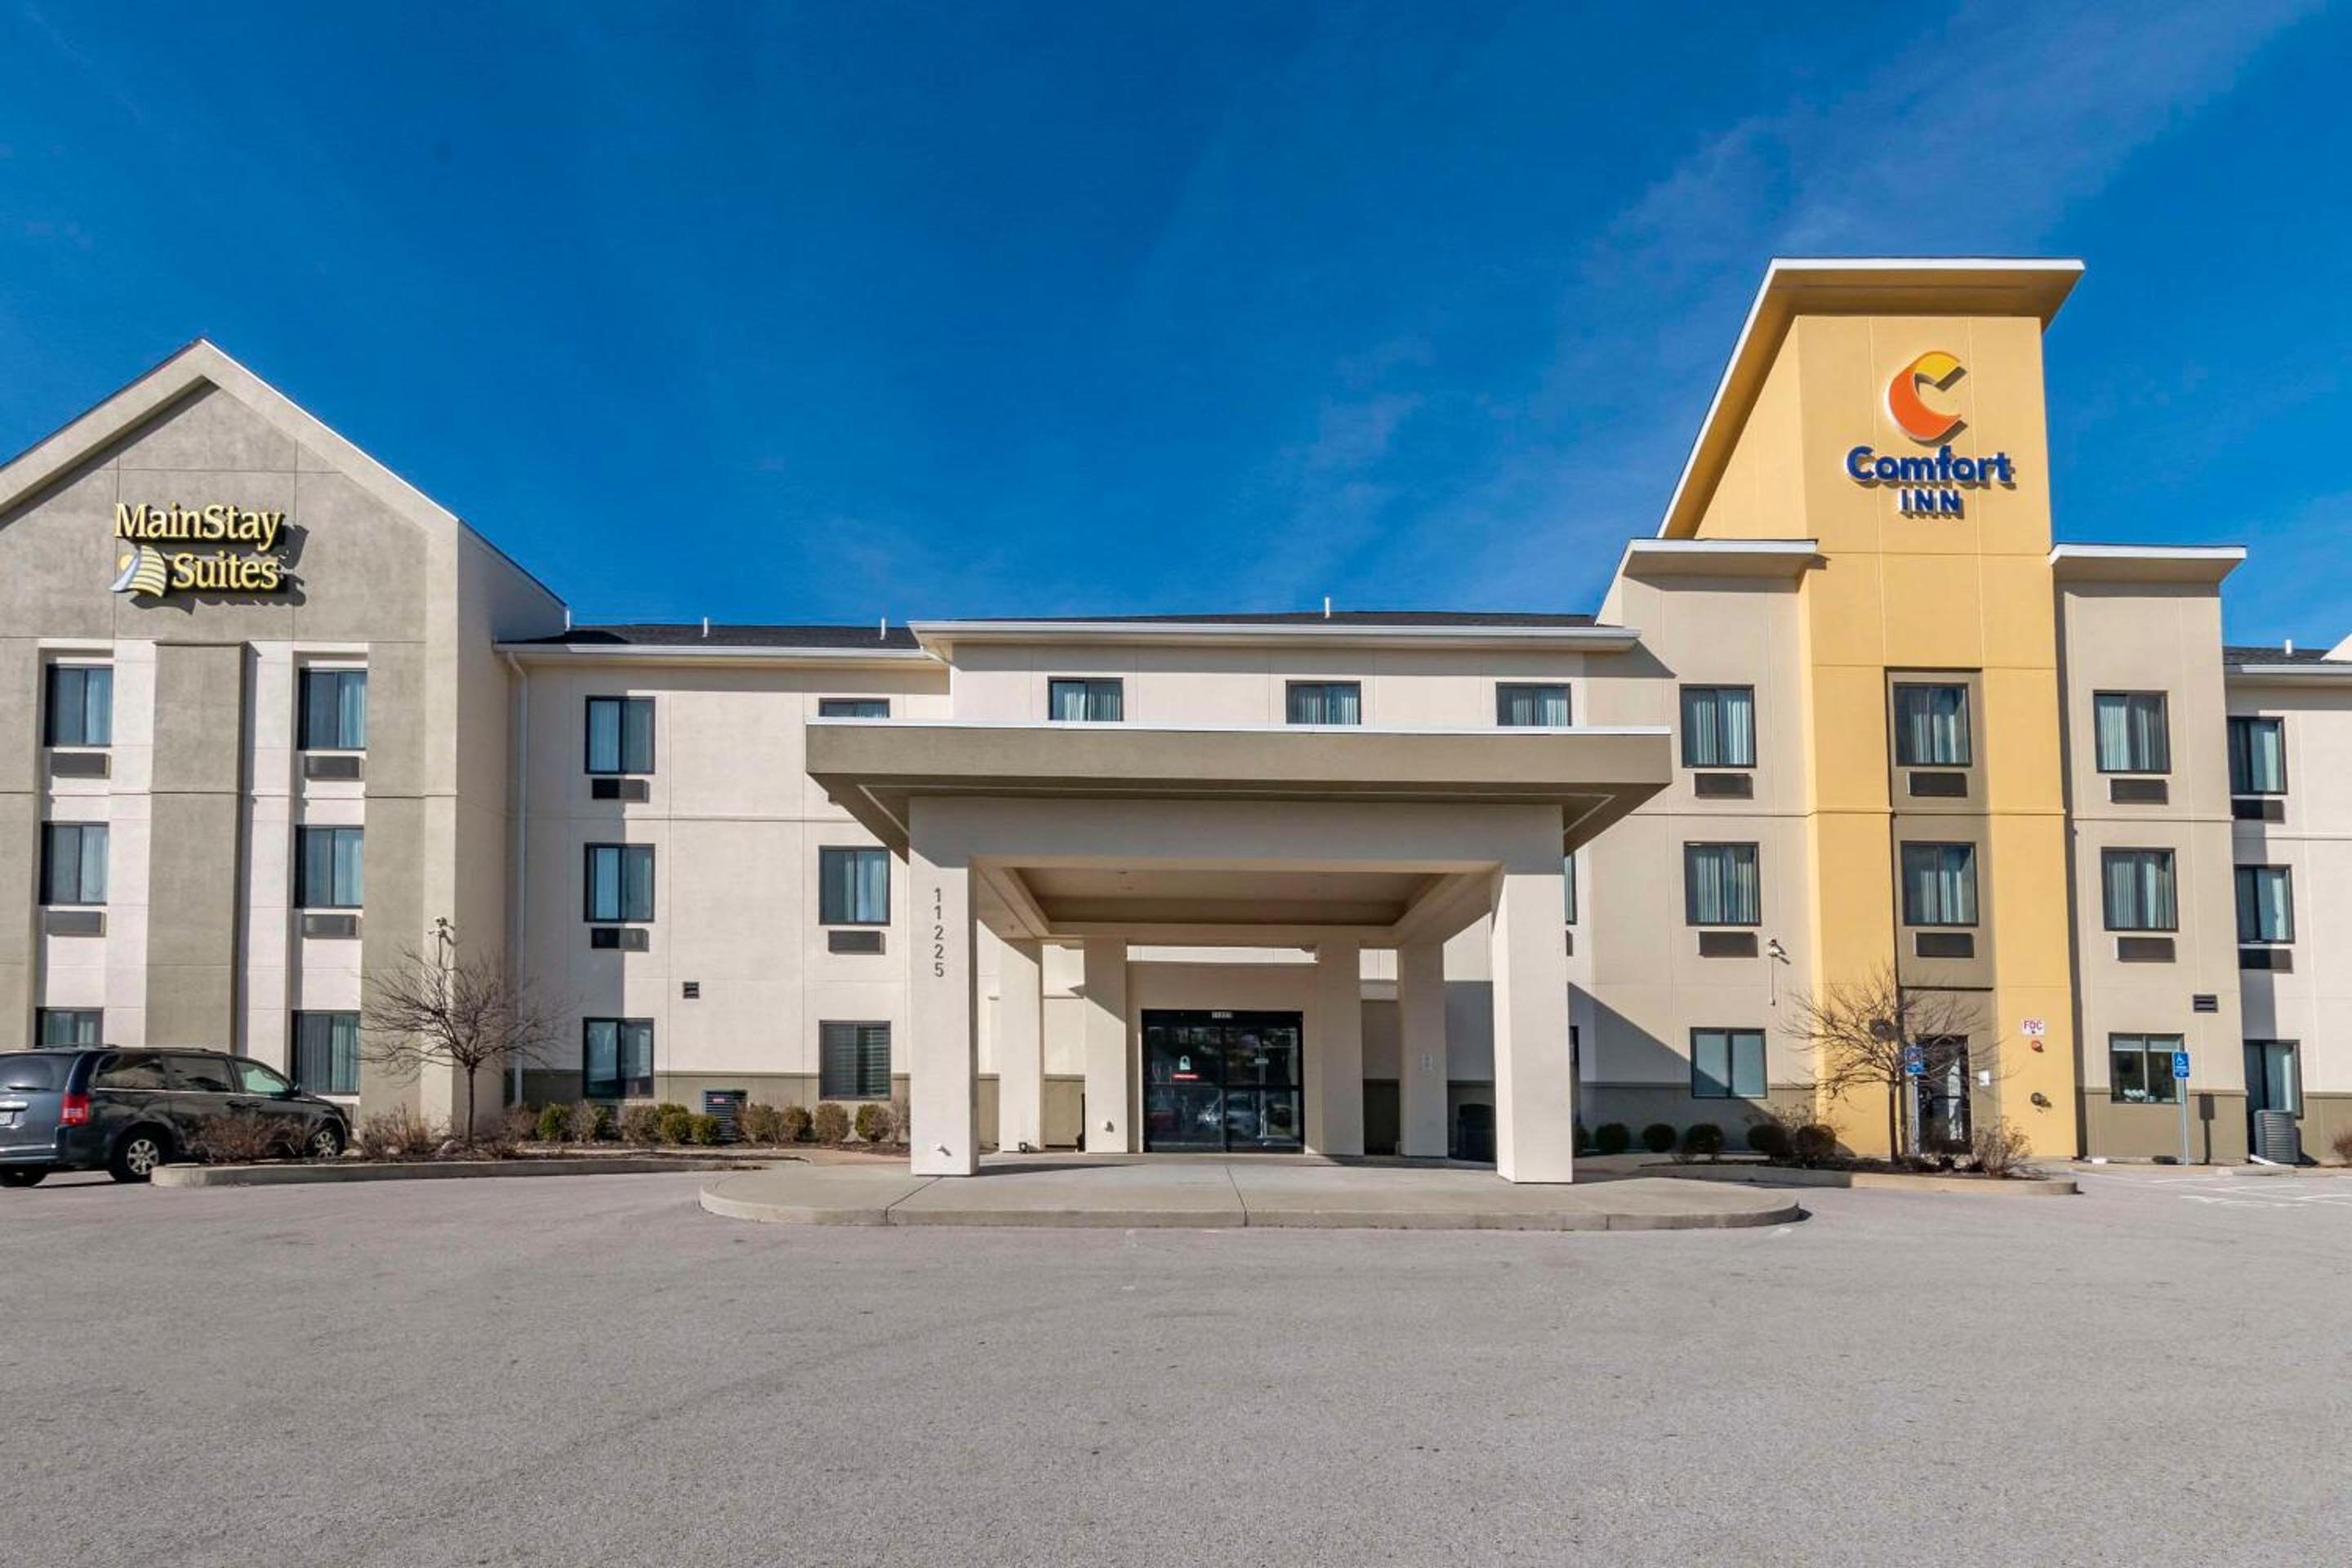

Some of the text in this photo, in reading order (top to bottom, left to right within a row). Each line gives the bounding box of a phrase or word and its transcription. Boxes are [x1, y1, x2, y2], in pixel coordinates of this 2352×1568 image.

[1845, 445, 2011, 482] Comfort
[1899, 488, 1960, 512] INN
[114, 501, 282, 552] MainStay
[171, 550, 279, 590] Suites
[933, 887, 945, 978] 11225
